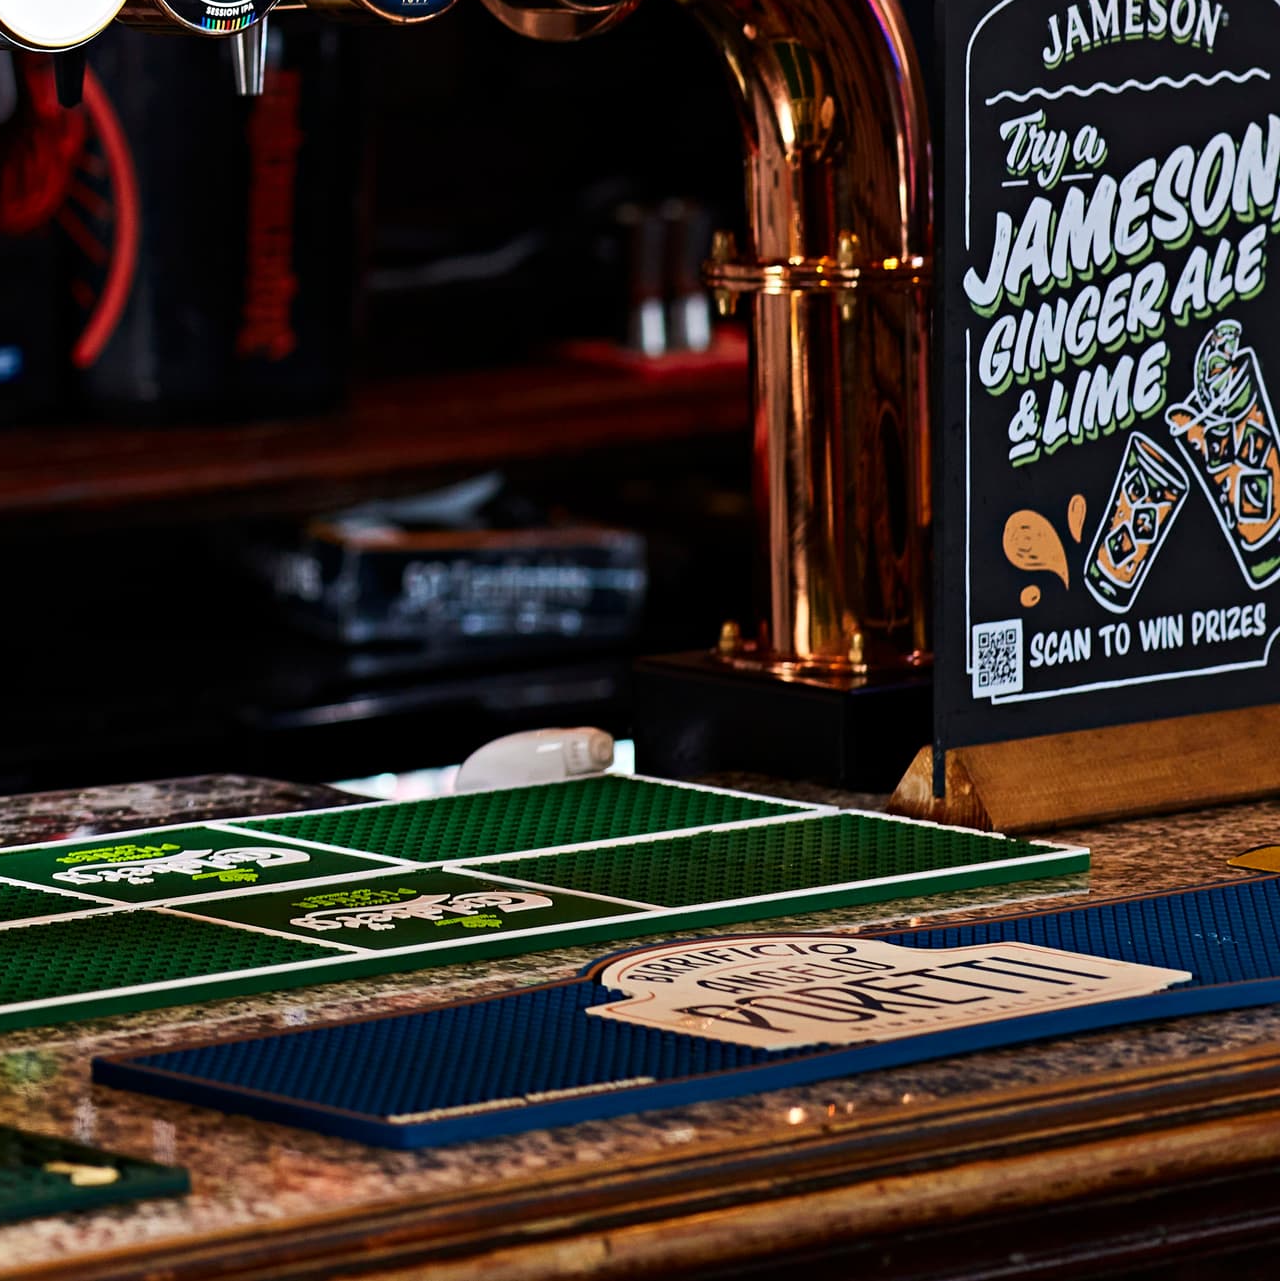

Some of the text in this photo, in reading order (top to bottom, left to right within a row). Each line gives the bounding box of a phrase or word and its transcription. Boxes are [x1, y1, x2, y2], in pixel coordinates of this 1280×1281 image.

[205, 1, 255, 18] SESSION IPA
[999, 109, 1108, 190] Try a
[978, 223, 1268, 396] GINGER ALE
[1007, 341, 1171, 466] & LIME
[1029, 601, 1268, 669] SCAN TO WIN PRIZES
[626, 941, 858, 985] BIRRIFICIO
[678, 956, 1110, 1034] PORETTI
[697, 956, 897, 996] ANGELO
